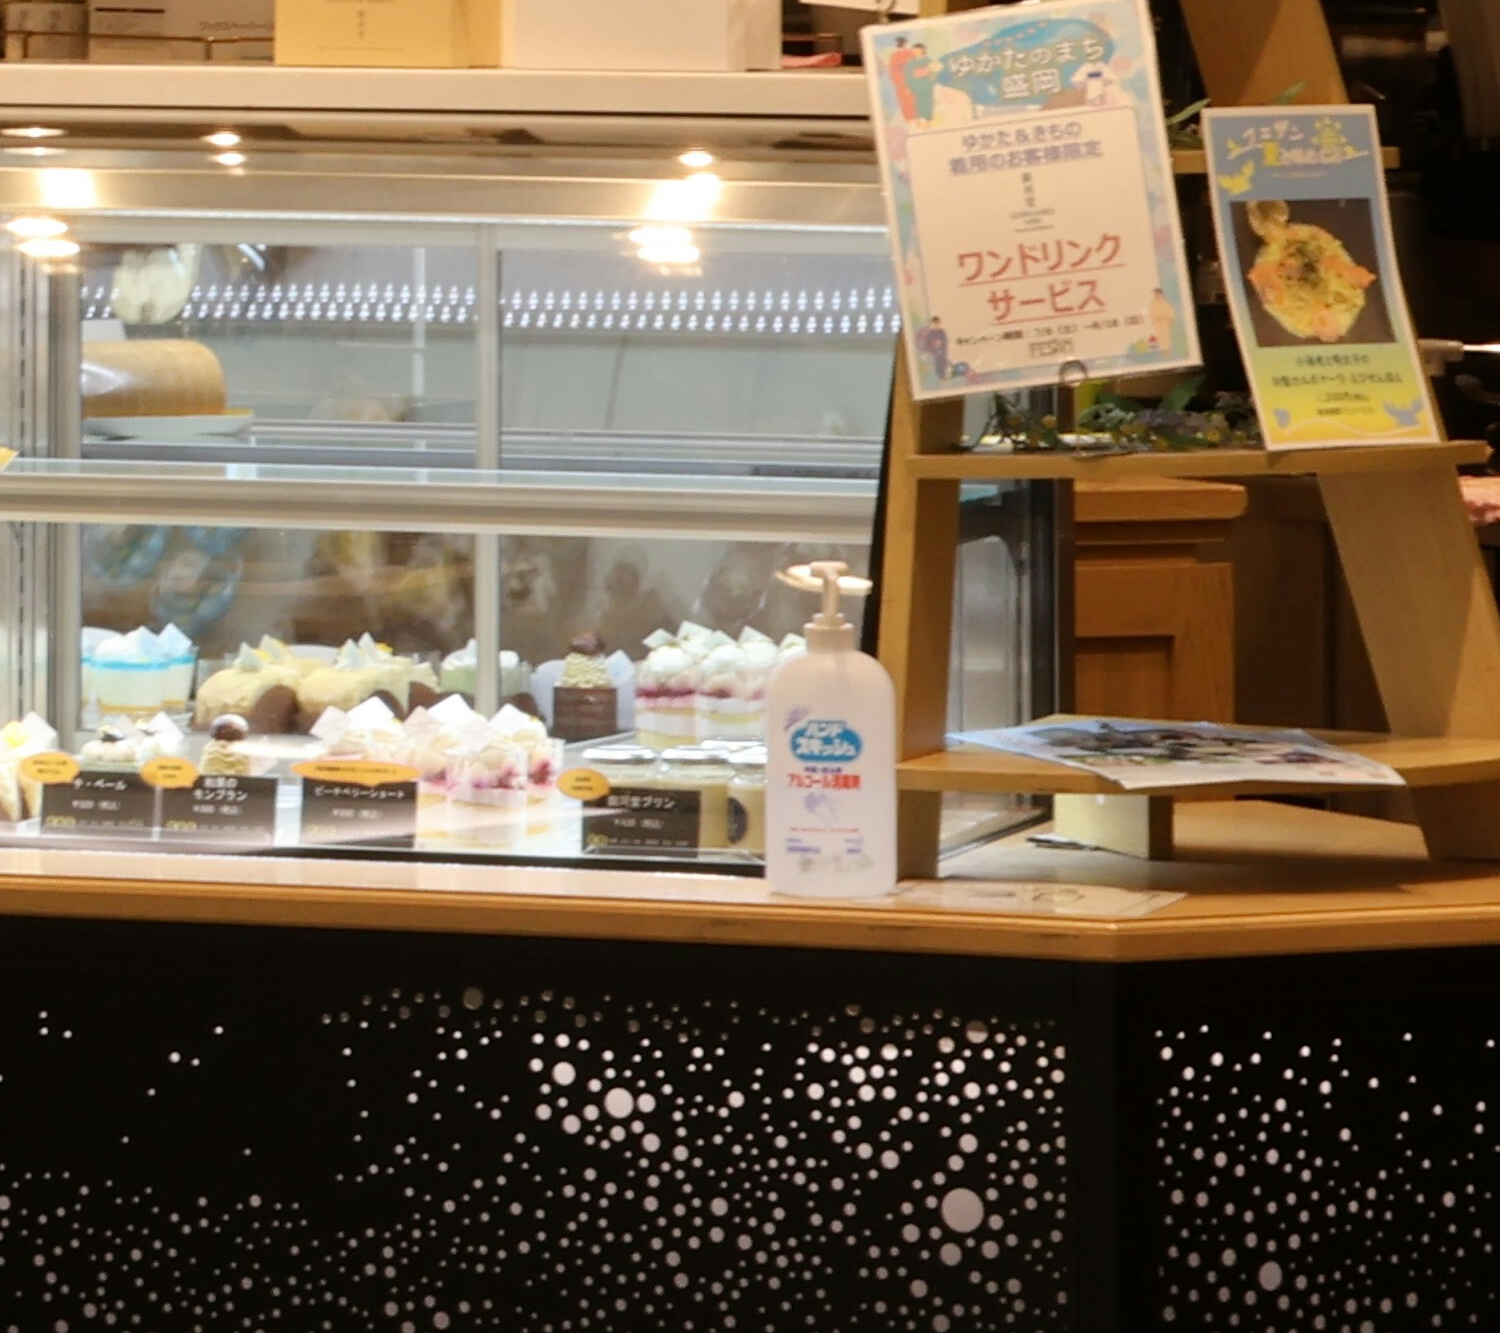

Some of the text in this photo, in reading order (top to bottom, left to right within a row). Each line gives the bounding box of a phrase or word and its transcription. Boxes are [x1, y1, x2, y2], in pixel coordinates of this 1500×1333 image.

[949, 37, 1105, 79] ゆかたのまち
[1002, 68, 1062, 100] 盛岡
[956, 232, 1125, 283] ワンドリンク
[986, 279, 1107, 323] サービス
